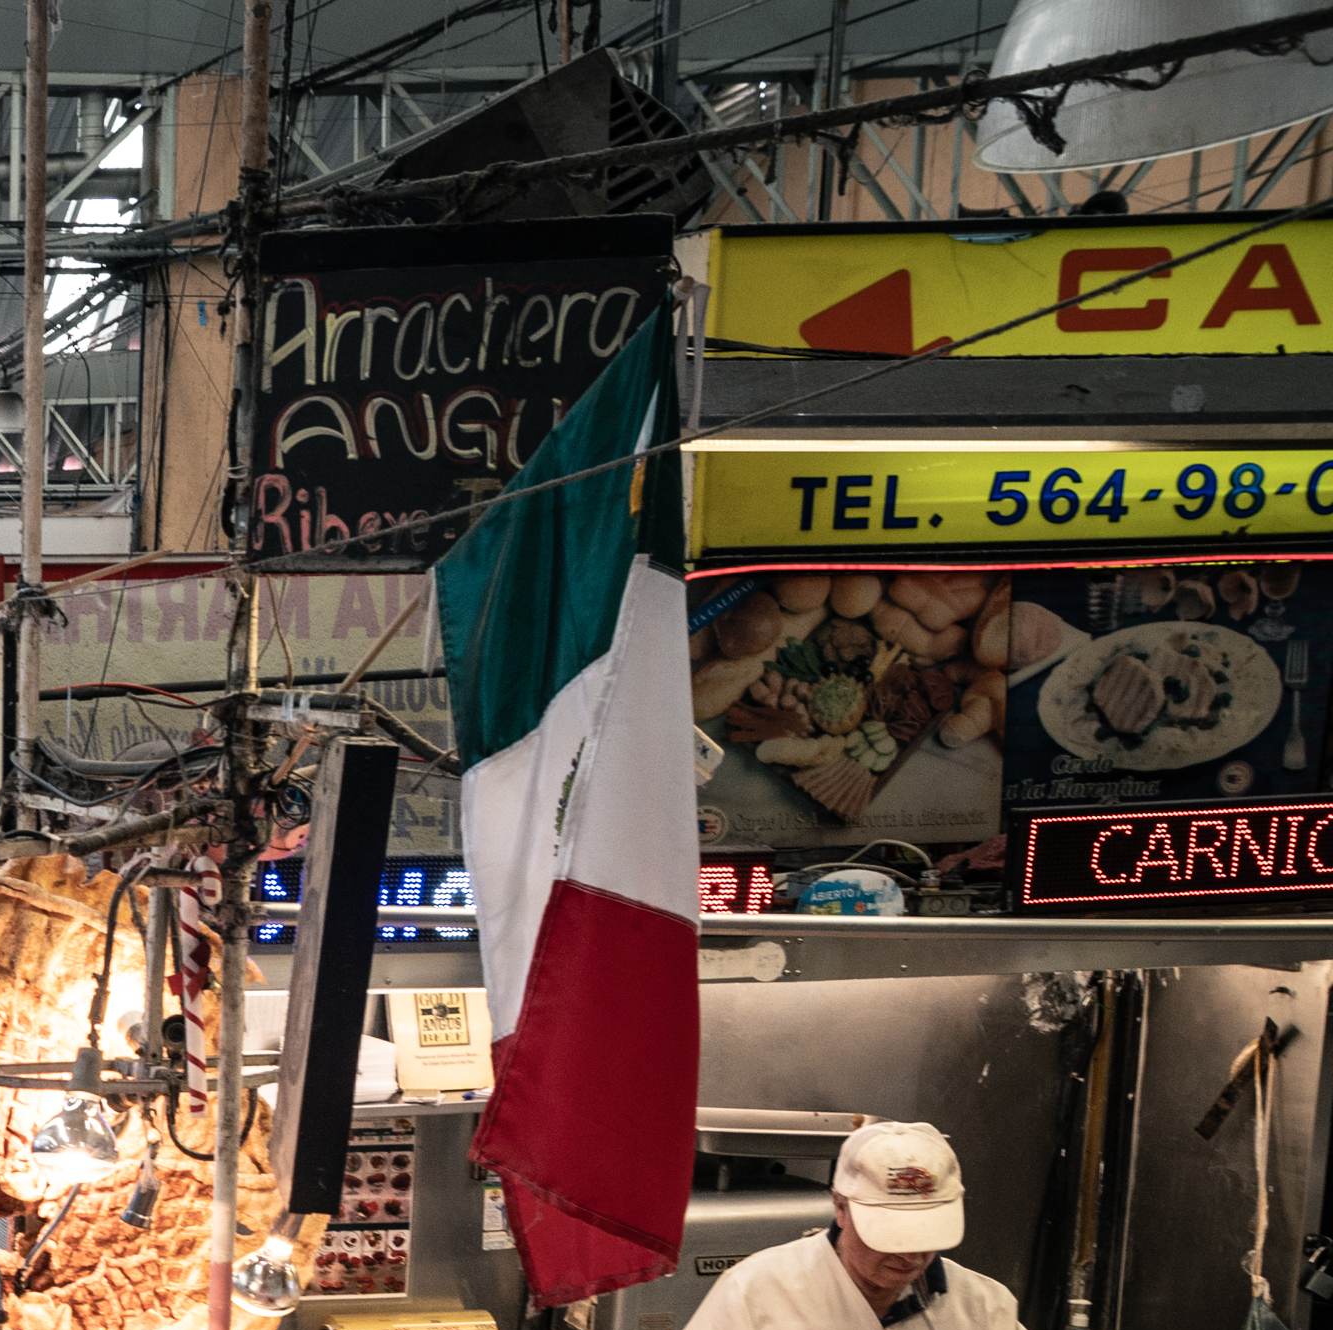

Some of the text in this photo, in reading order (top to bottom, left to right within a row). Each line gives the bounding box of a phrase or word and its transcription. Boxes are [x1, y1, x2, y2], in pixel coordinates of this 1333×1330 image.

[261, 276, 641, 393] Arrachera
[791, 474, 943, 531] TEL.
[810, 887, 855, 902] ABIERTO
[422, 1017, 463, 1032] ANGUS
[423, 1031, 465, 1042] BEEF
